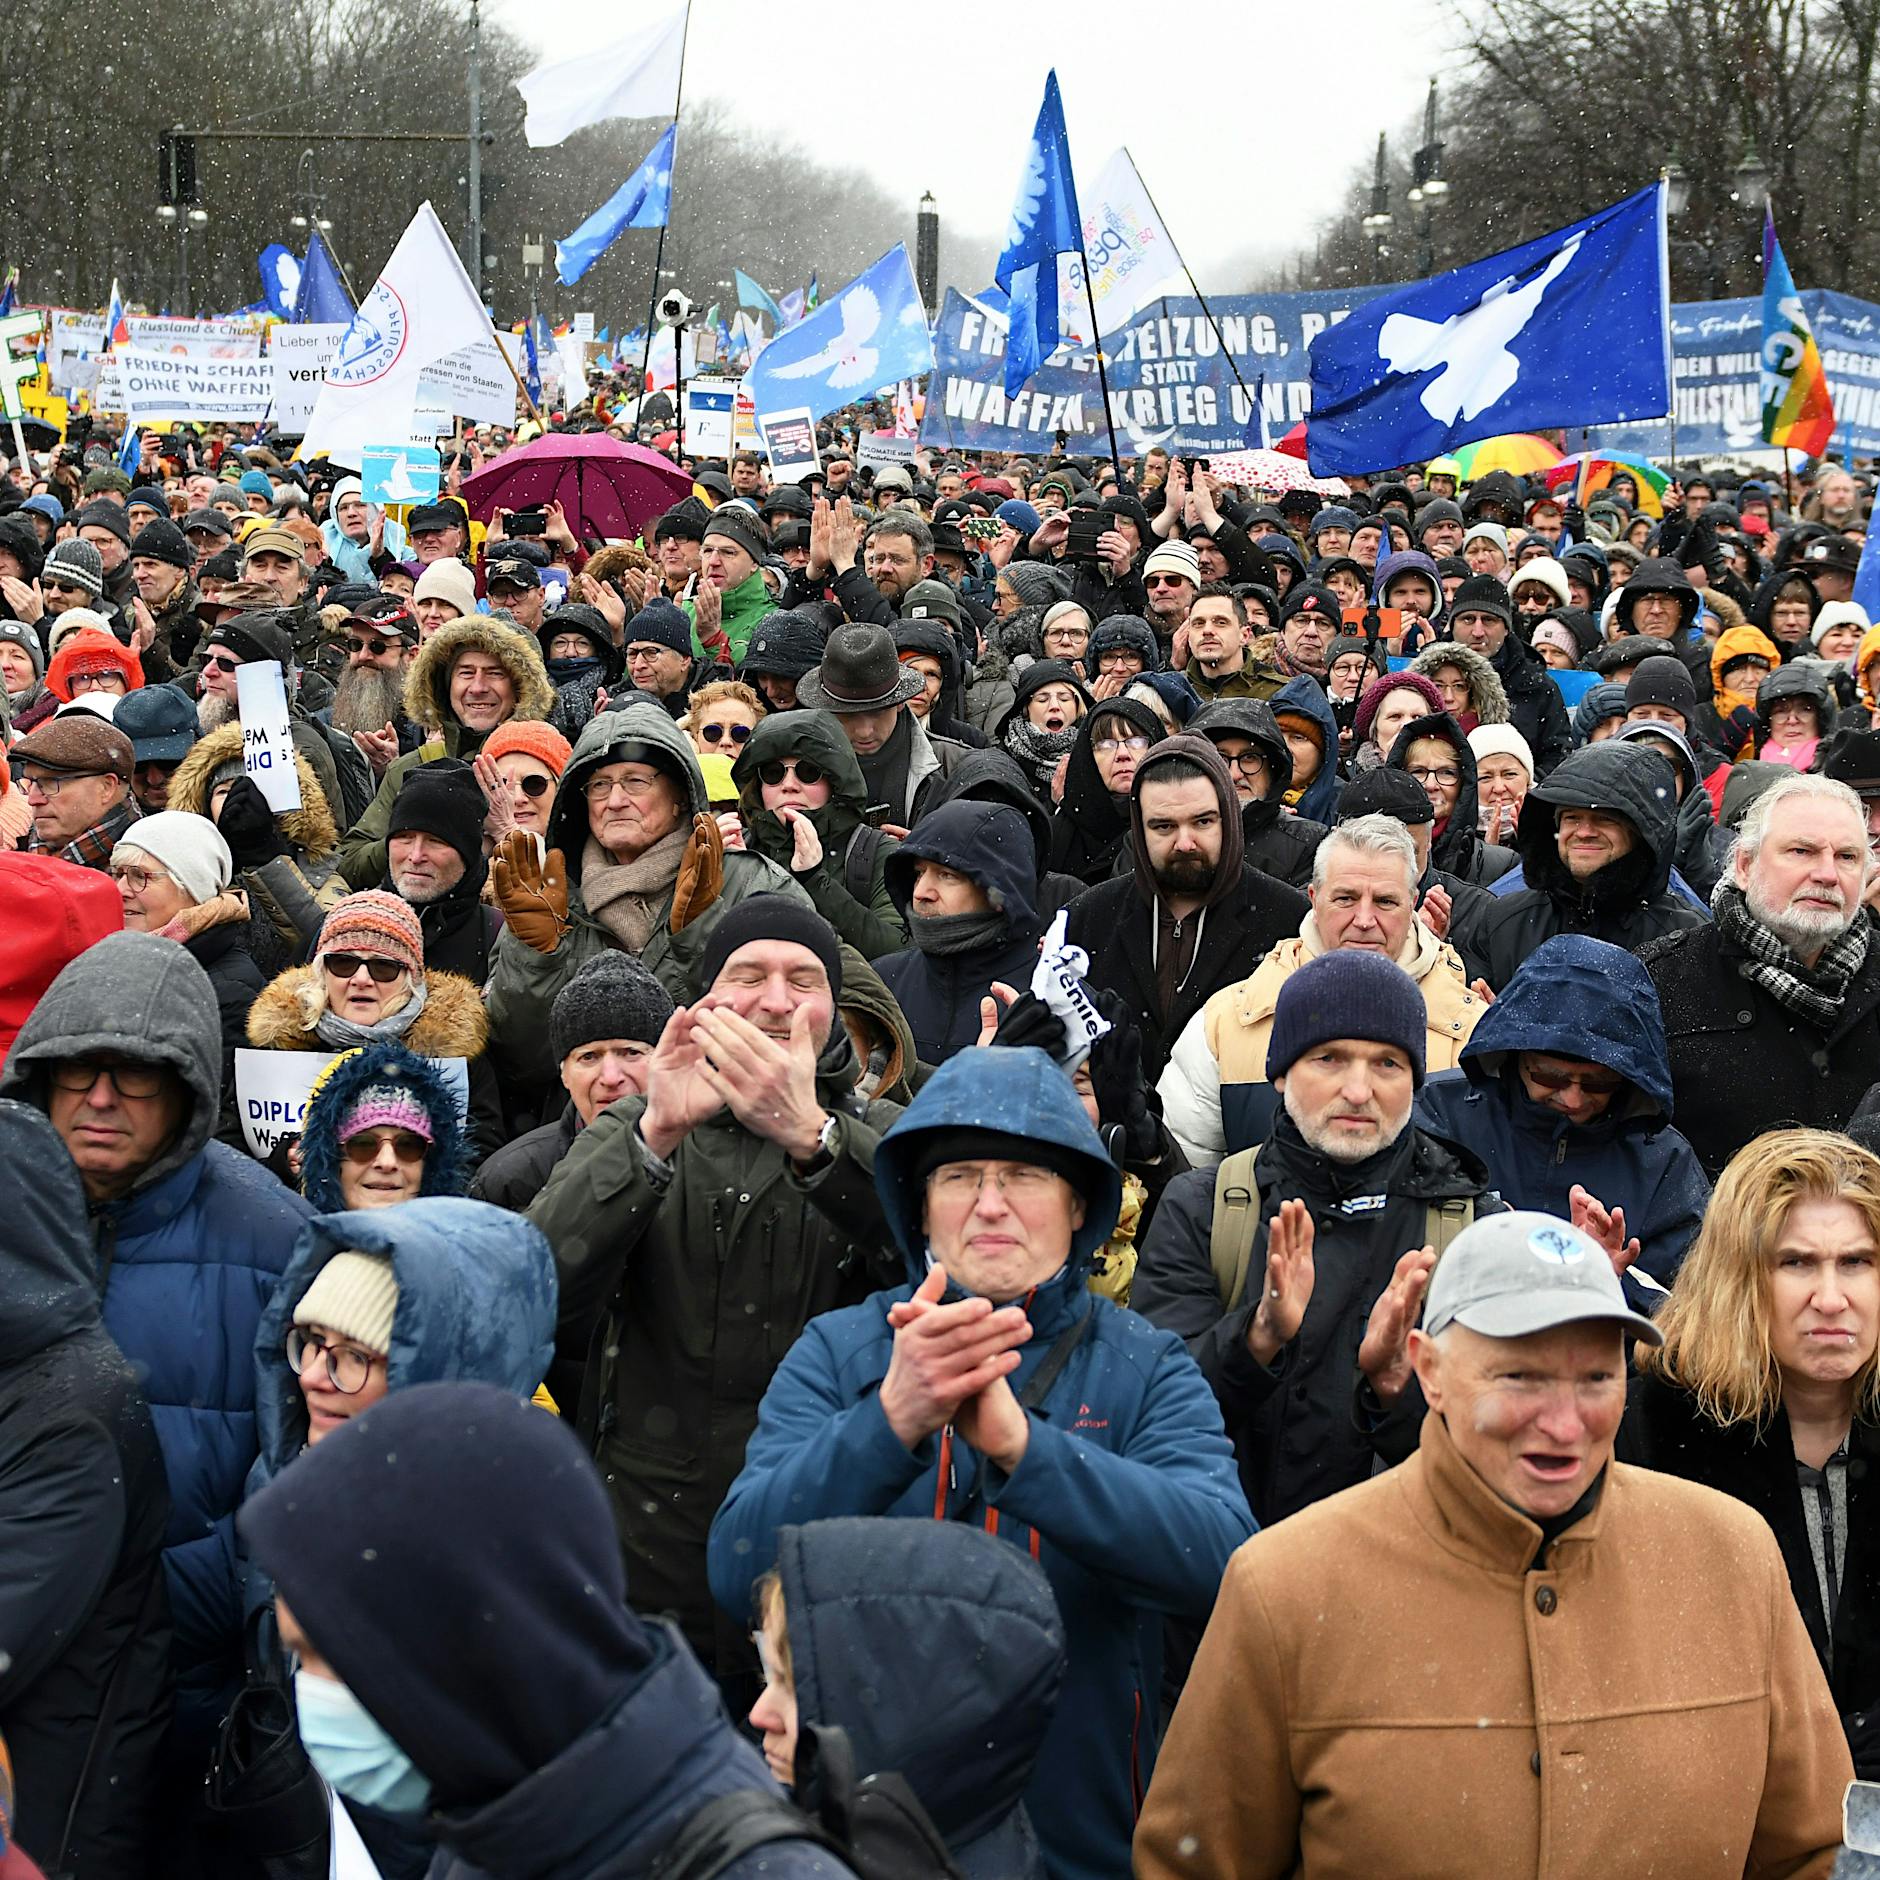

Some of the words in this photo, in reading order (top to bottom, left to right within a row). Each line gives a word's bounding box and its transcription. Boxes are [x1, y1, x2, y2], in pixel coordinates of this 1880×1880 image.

[279, 336, 318, 348] Lieber
[125, 357, 199, 376] FRIEDEN
[1140, 361, 1198, 385] STATT
[128, 377, 180, 393] OHNE
[187, 382, 271, 395] WAFFEN!
[945, 377, 1095, 434] WAFFEN,
[1107, 385, 1218, 429] KRIEG
[1230, 382, 1312, 424] UND
[410, 435, 432, 443] statt
